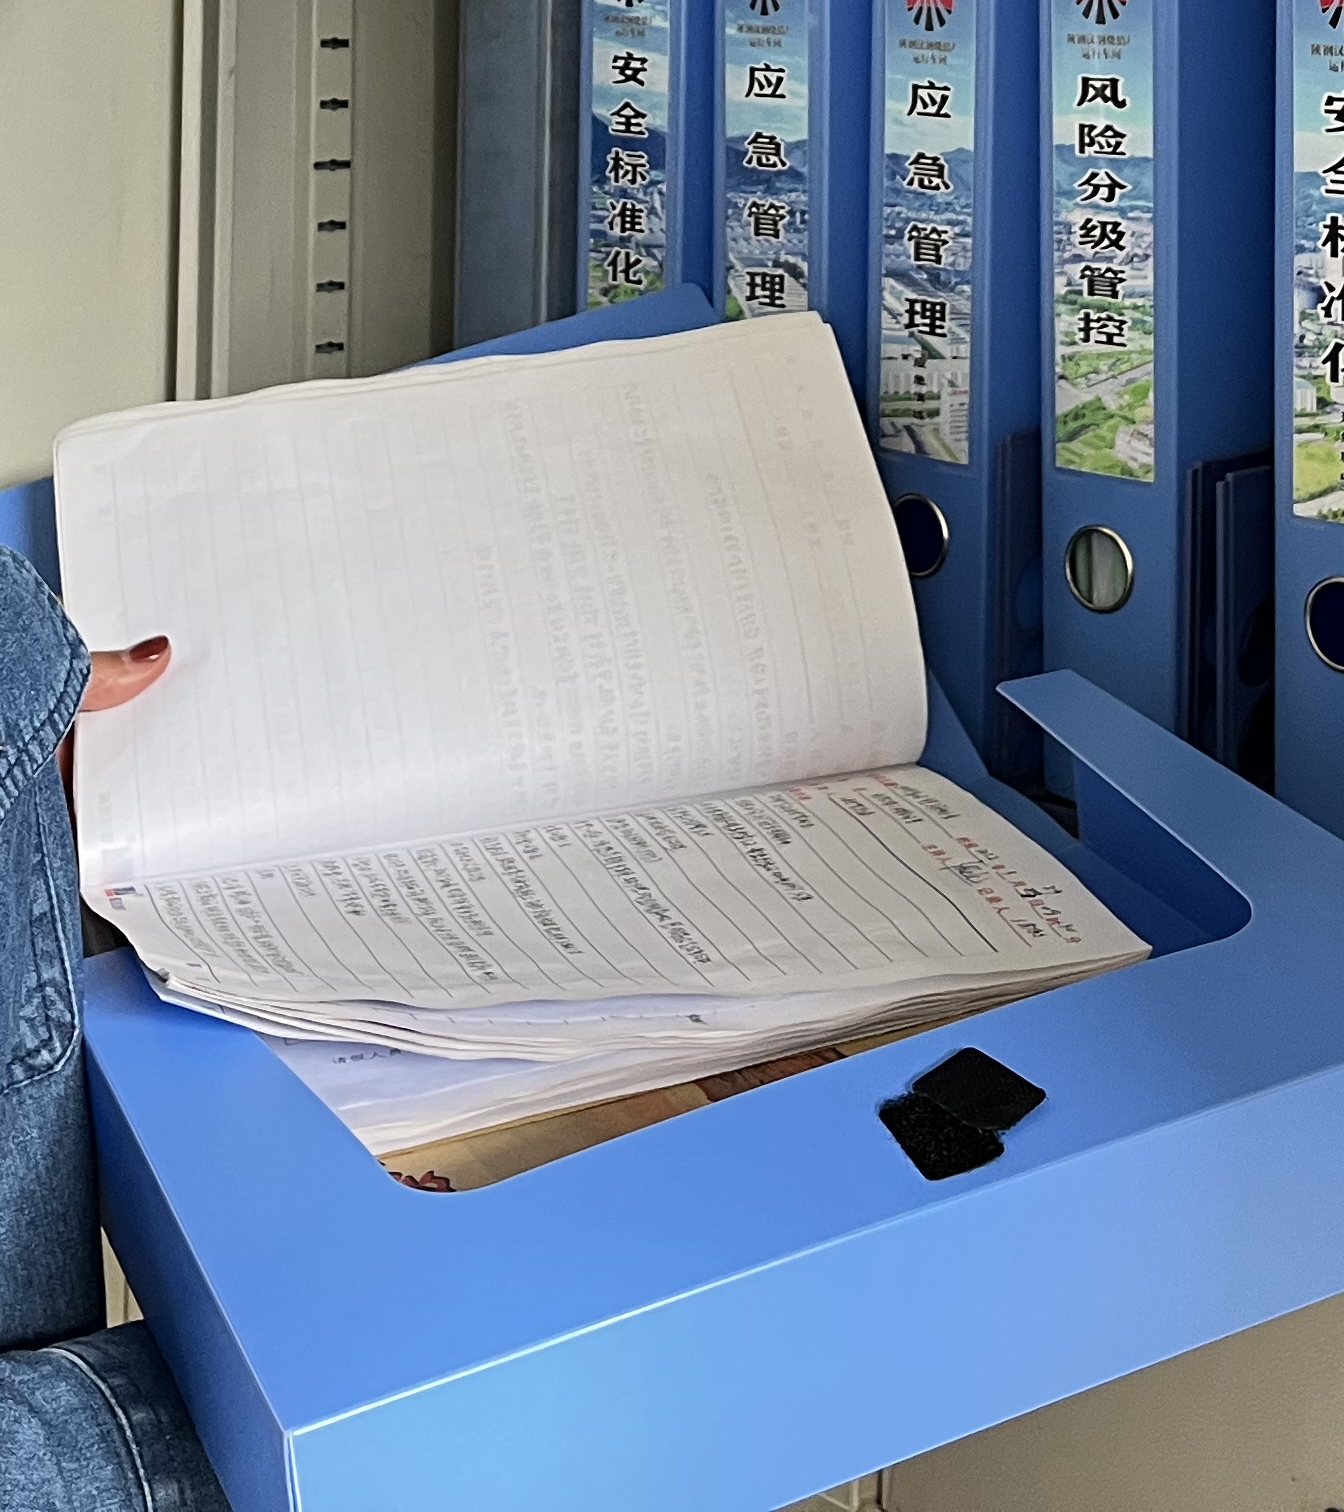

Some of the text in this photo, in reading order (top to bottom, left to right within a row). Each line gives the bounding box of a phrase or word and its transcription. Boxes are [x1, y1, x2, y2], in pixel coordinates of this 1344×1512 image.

[607, 52, 649, 286] 安全标准化
[744, 63, 787, 309] 应急管理
[904, 81, 952, 337] 应急管理
[1076, 76, 1127, 347] 风险分级管控
